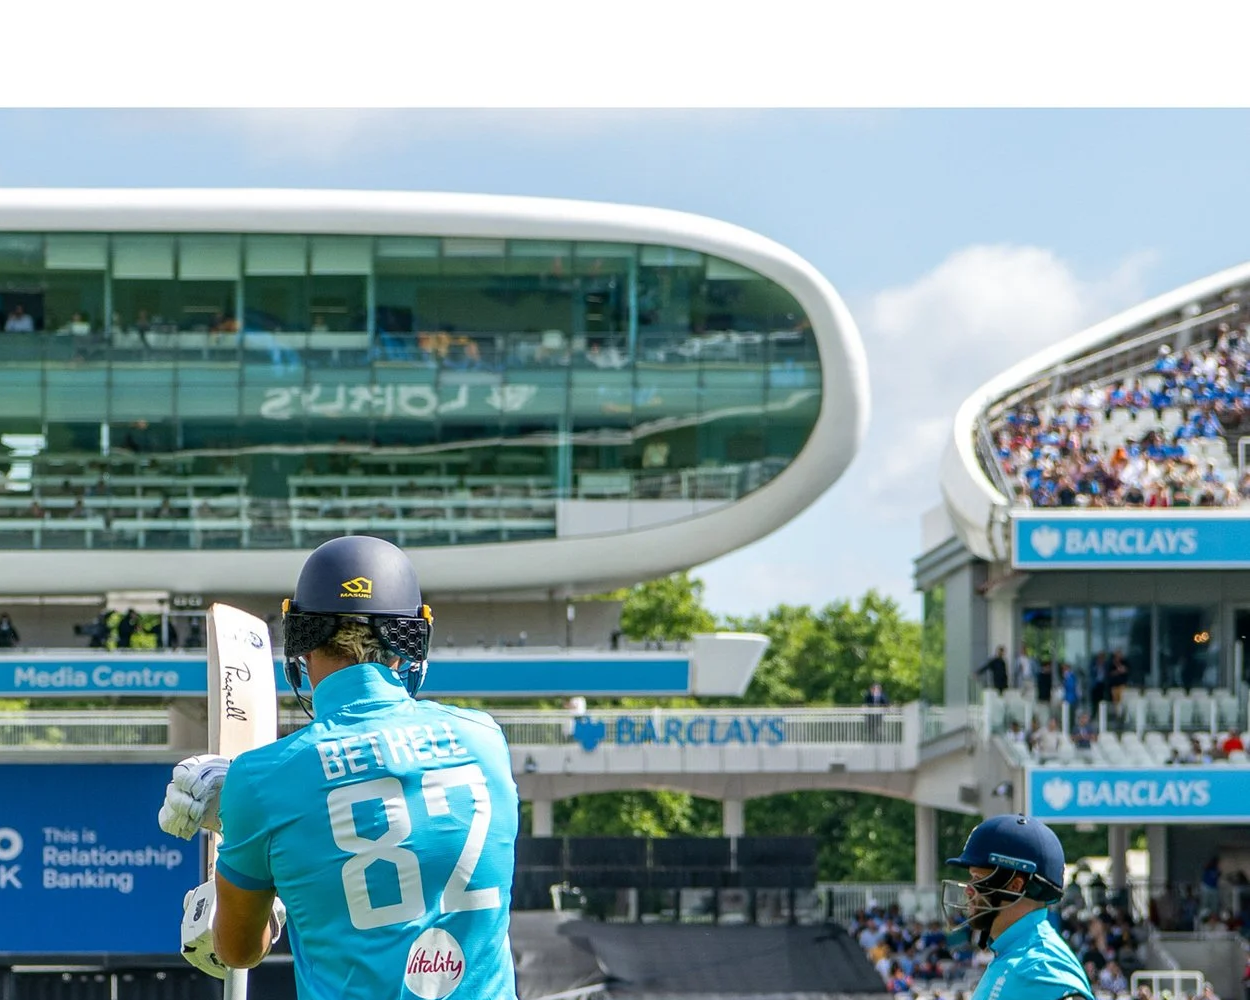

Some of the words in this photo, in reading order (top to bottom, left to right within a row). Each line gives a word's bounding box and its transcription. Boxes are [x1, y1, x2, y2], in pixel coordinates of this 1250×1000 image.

[1065, 528, 1198, 555] BARCLAYS
[14, 666, 87, 688] Media
[92, 666, 180, 688] Centre
[616, 716, 786, 747] BARCLAYS
[316, 722, 469, 780] BETHELL
[1077, 780, 1211, 807] BARCLAYS
[42, 827, 78, 843] This
[82, 827, 97, 843] is
[326, 763, 501, 930] 82
[42, 846, 183, 871] Relationship
[42, 868, 134, 894] Banking
[407, 946, 463, 981] Vitality
